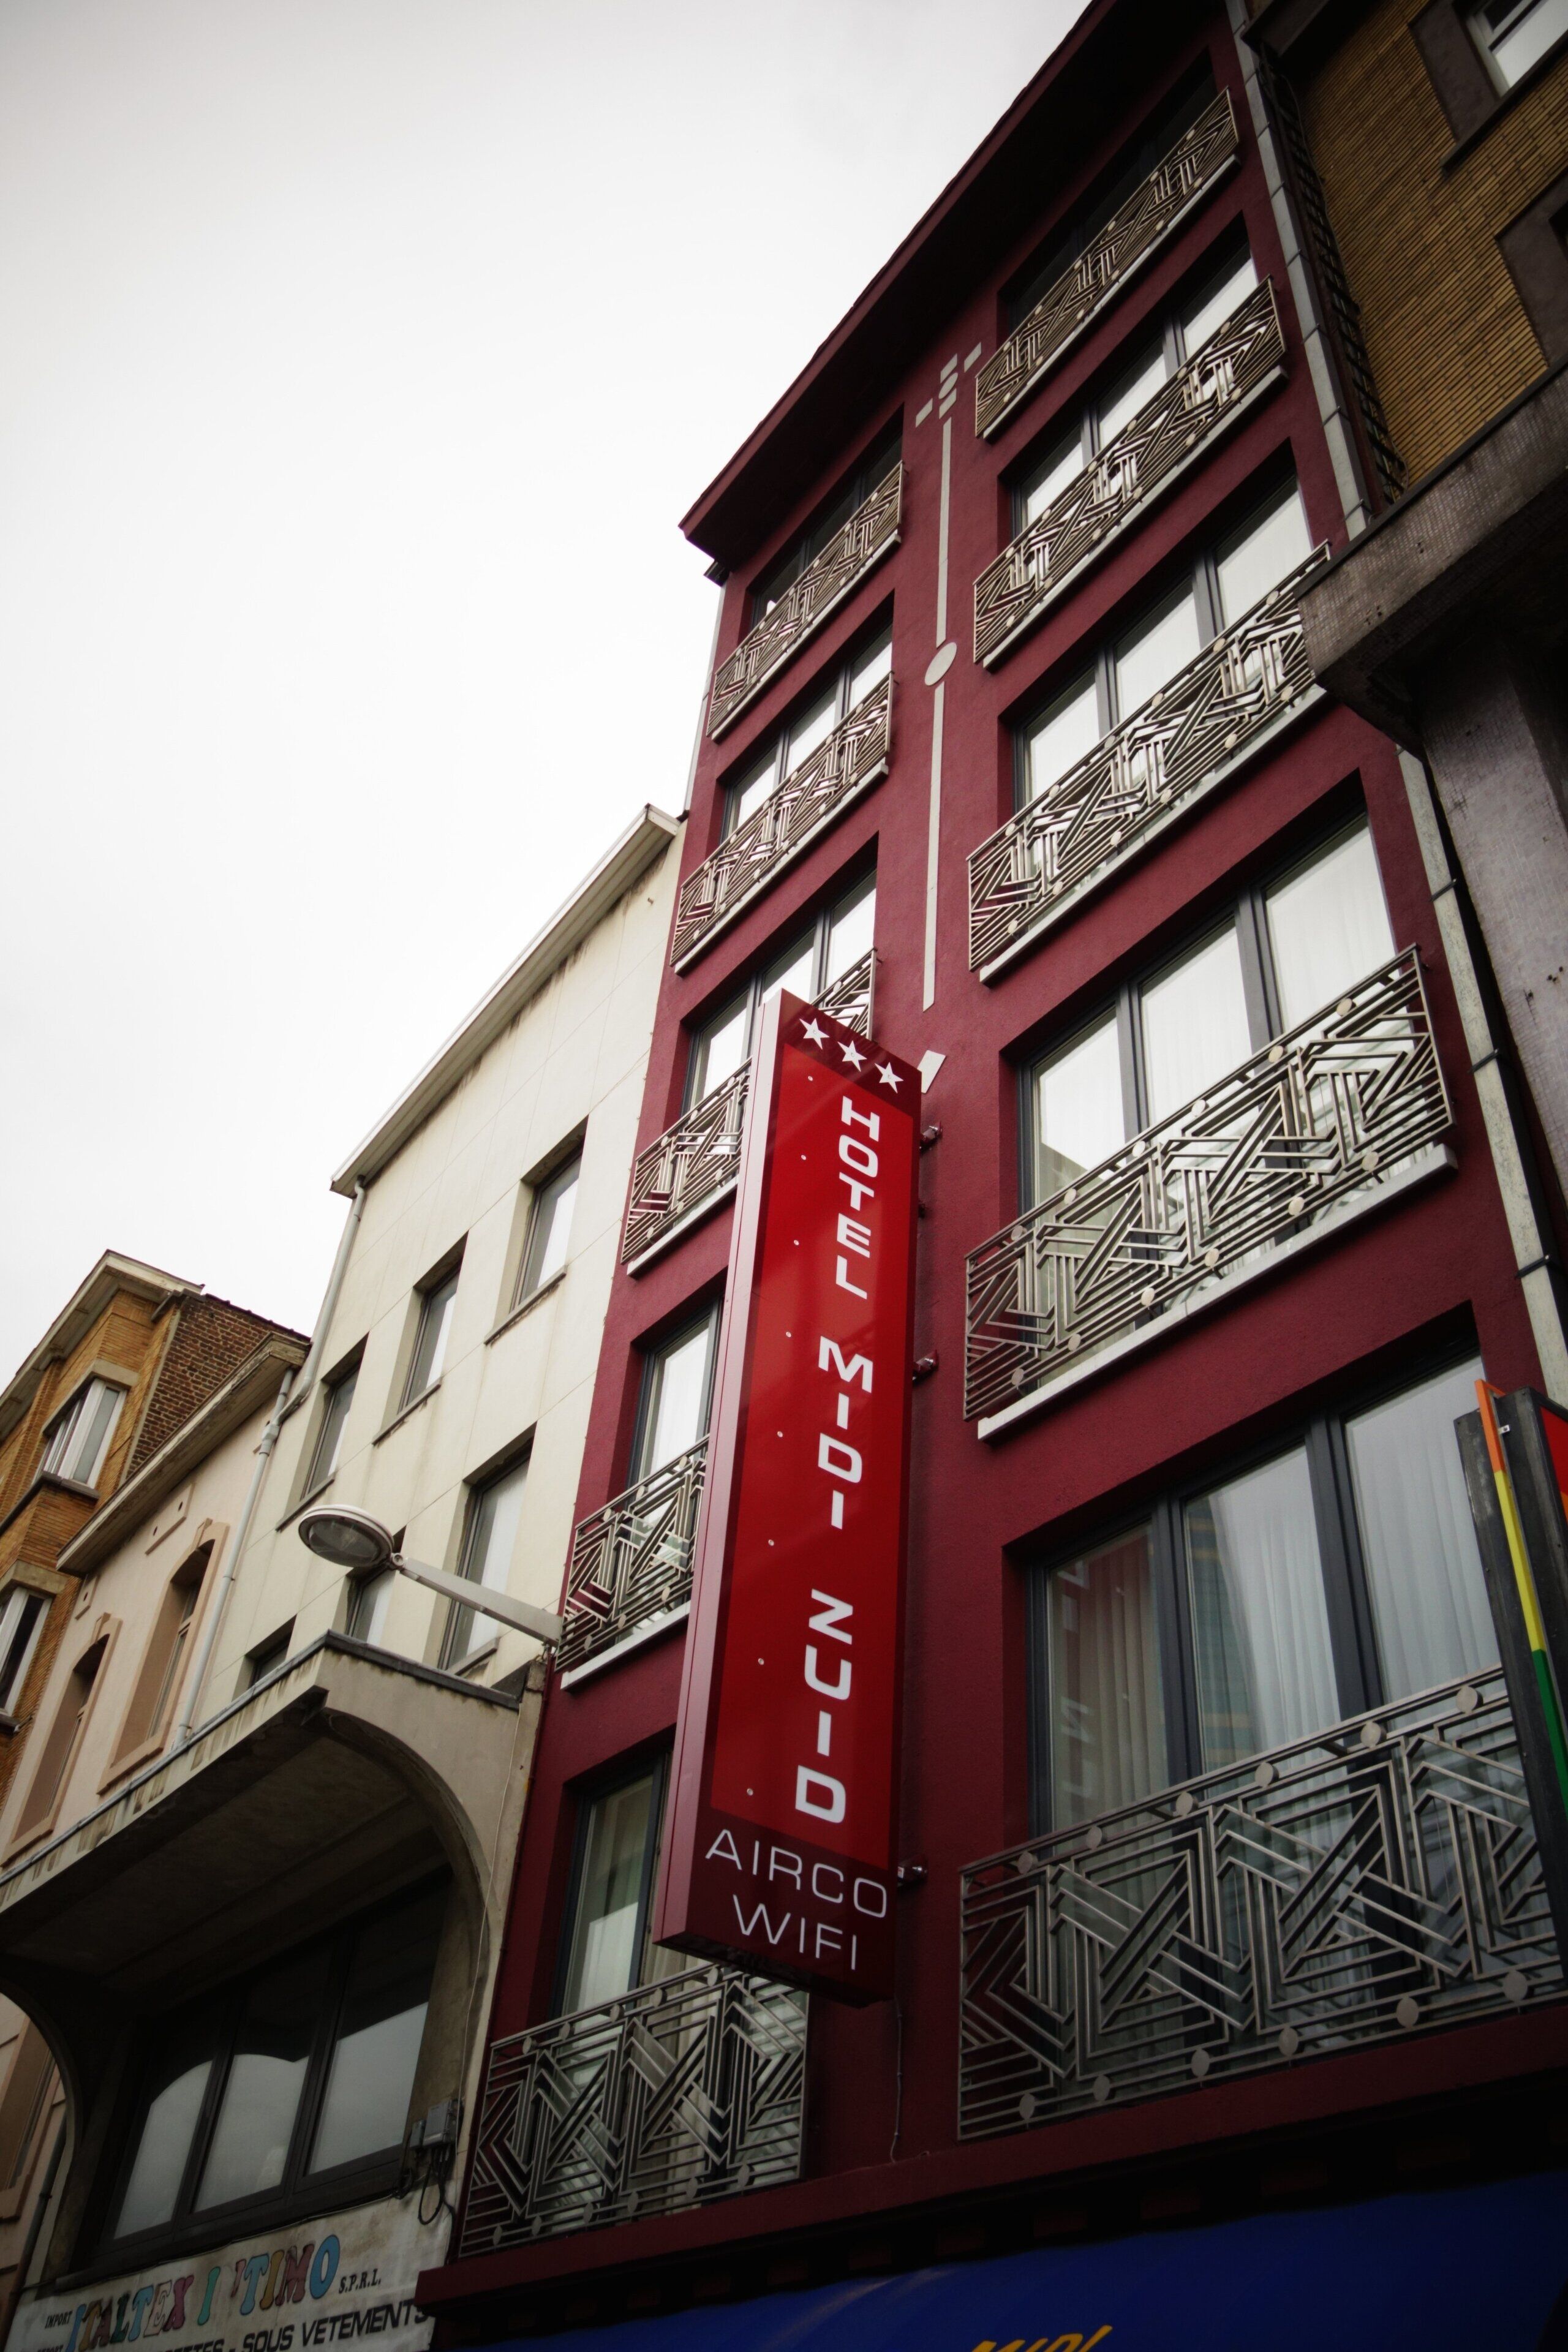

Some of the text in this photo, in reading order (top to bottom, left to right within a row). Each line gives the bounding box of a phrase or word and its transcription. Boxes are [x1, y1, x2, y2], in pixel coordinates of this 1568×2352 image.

[795, 1096, 880, 1824] HOTEL MIDI ZUID
[705, 1829, 887, 1918] AIRCO
[733, 1894, 857, 1970] WIFI
[45, 2310, 72, 2329] IMPORT
[66, 2275, 194, 2352] ITALTEX
[339, 2269, 382, 2294] S.P.R.L.
[241, 2324, 294, 2352] SOUS
